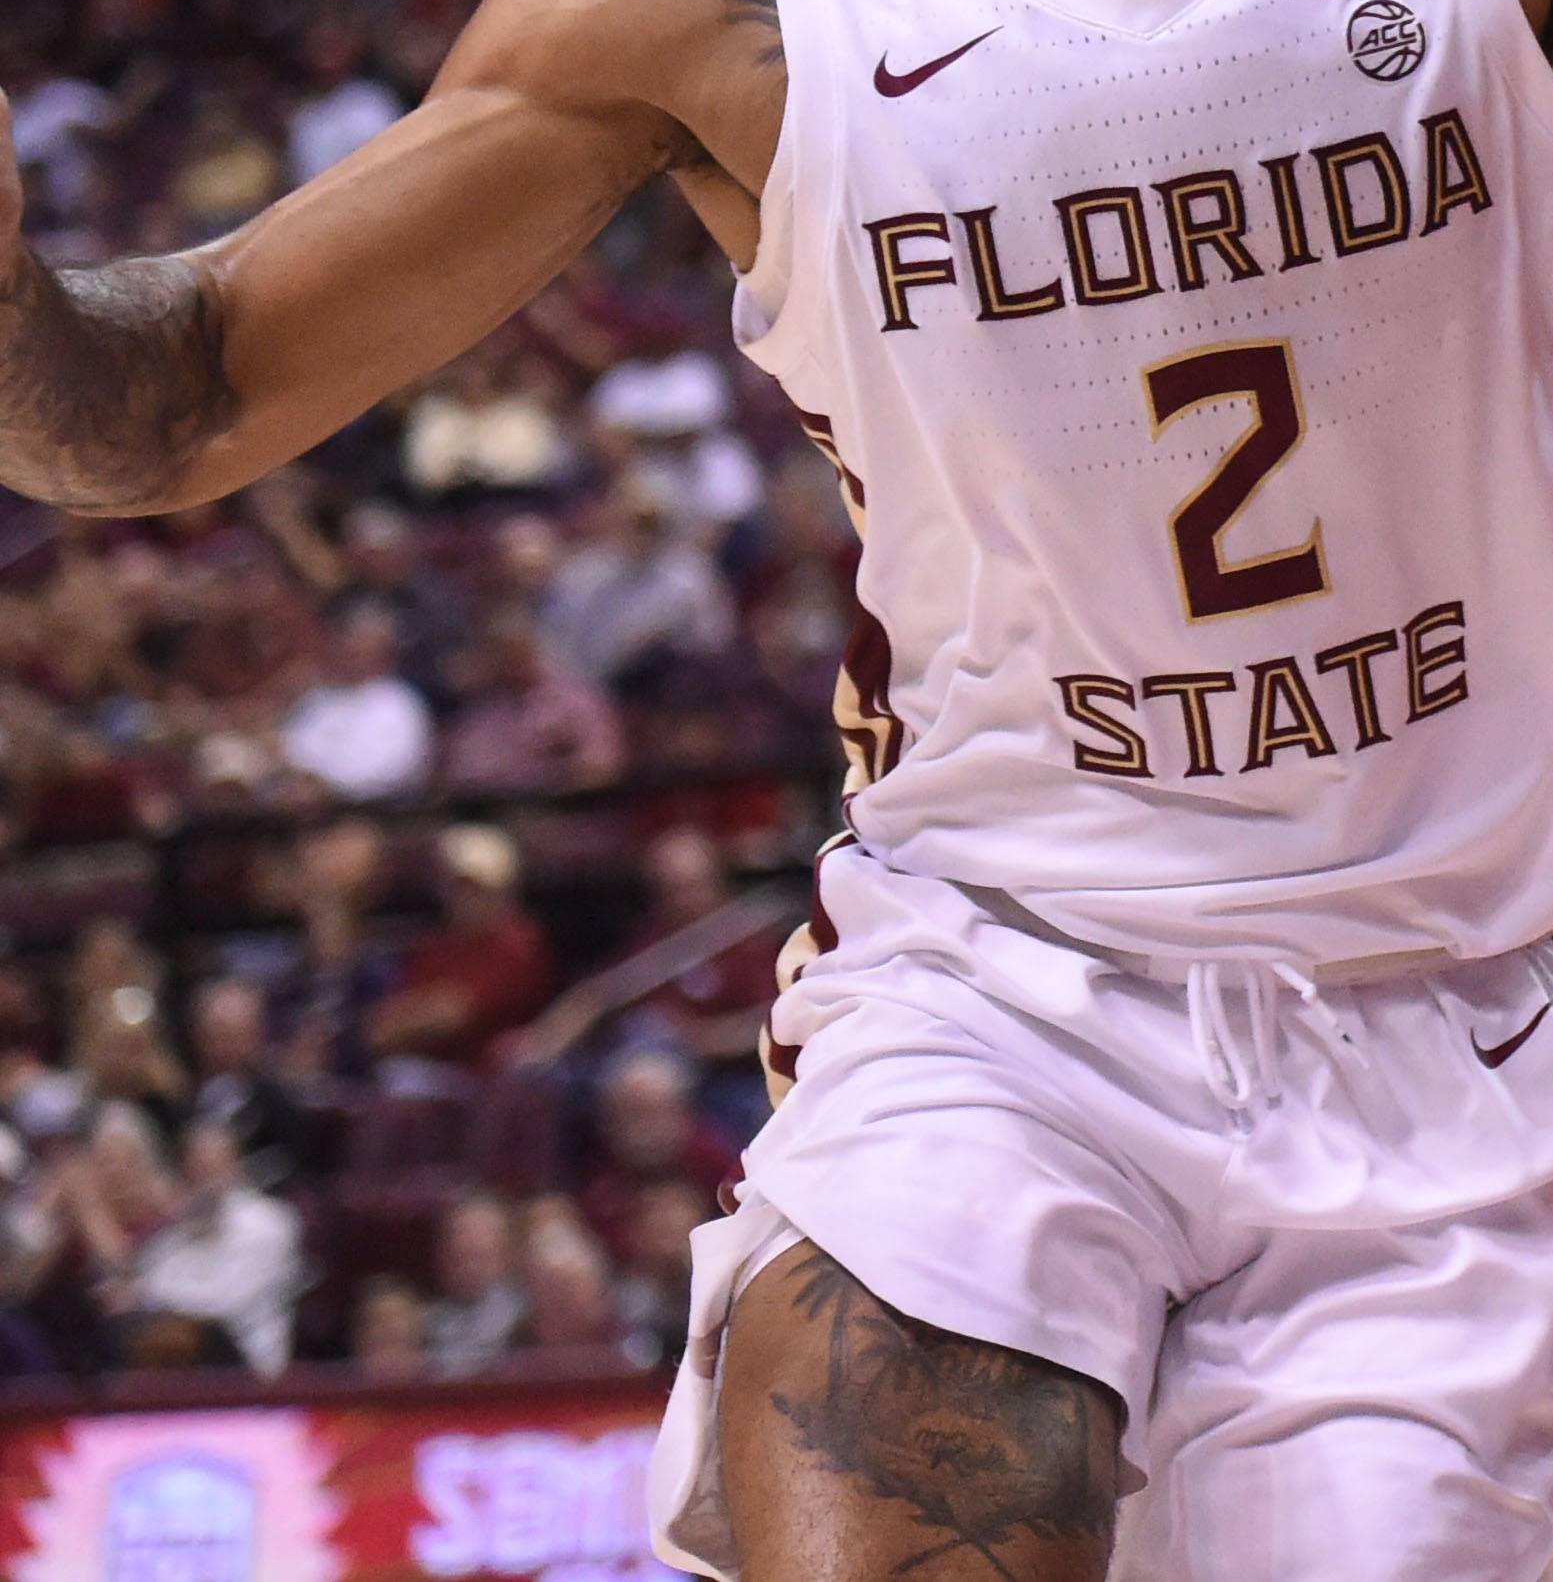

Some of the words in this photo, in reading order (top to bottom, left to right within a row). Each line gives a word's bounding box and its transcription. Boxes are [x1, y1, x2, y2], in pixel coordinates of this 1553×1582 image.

[1358, 17, 1417, 50] ACC
[861, 107, 1493, 333] FLORIDA
[1138, 335, 1333, 626] 2
[1052, 599, 1470, 780] STATE
